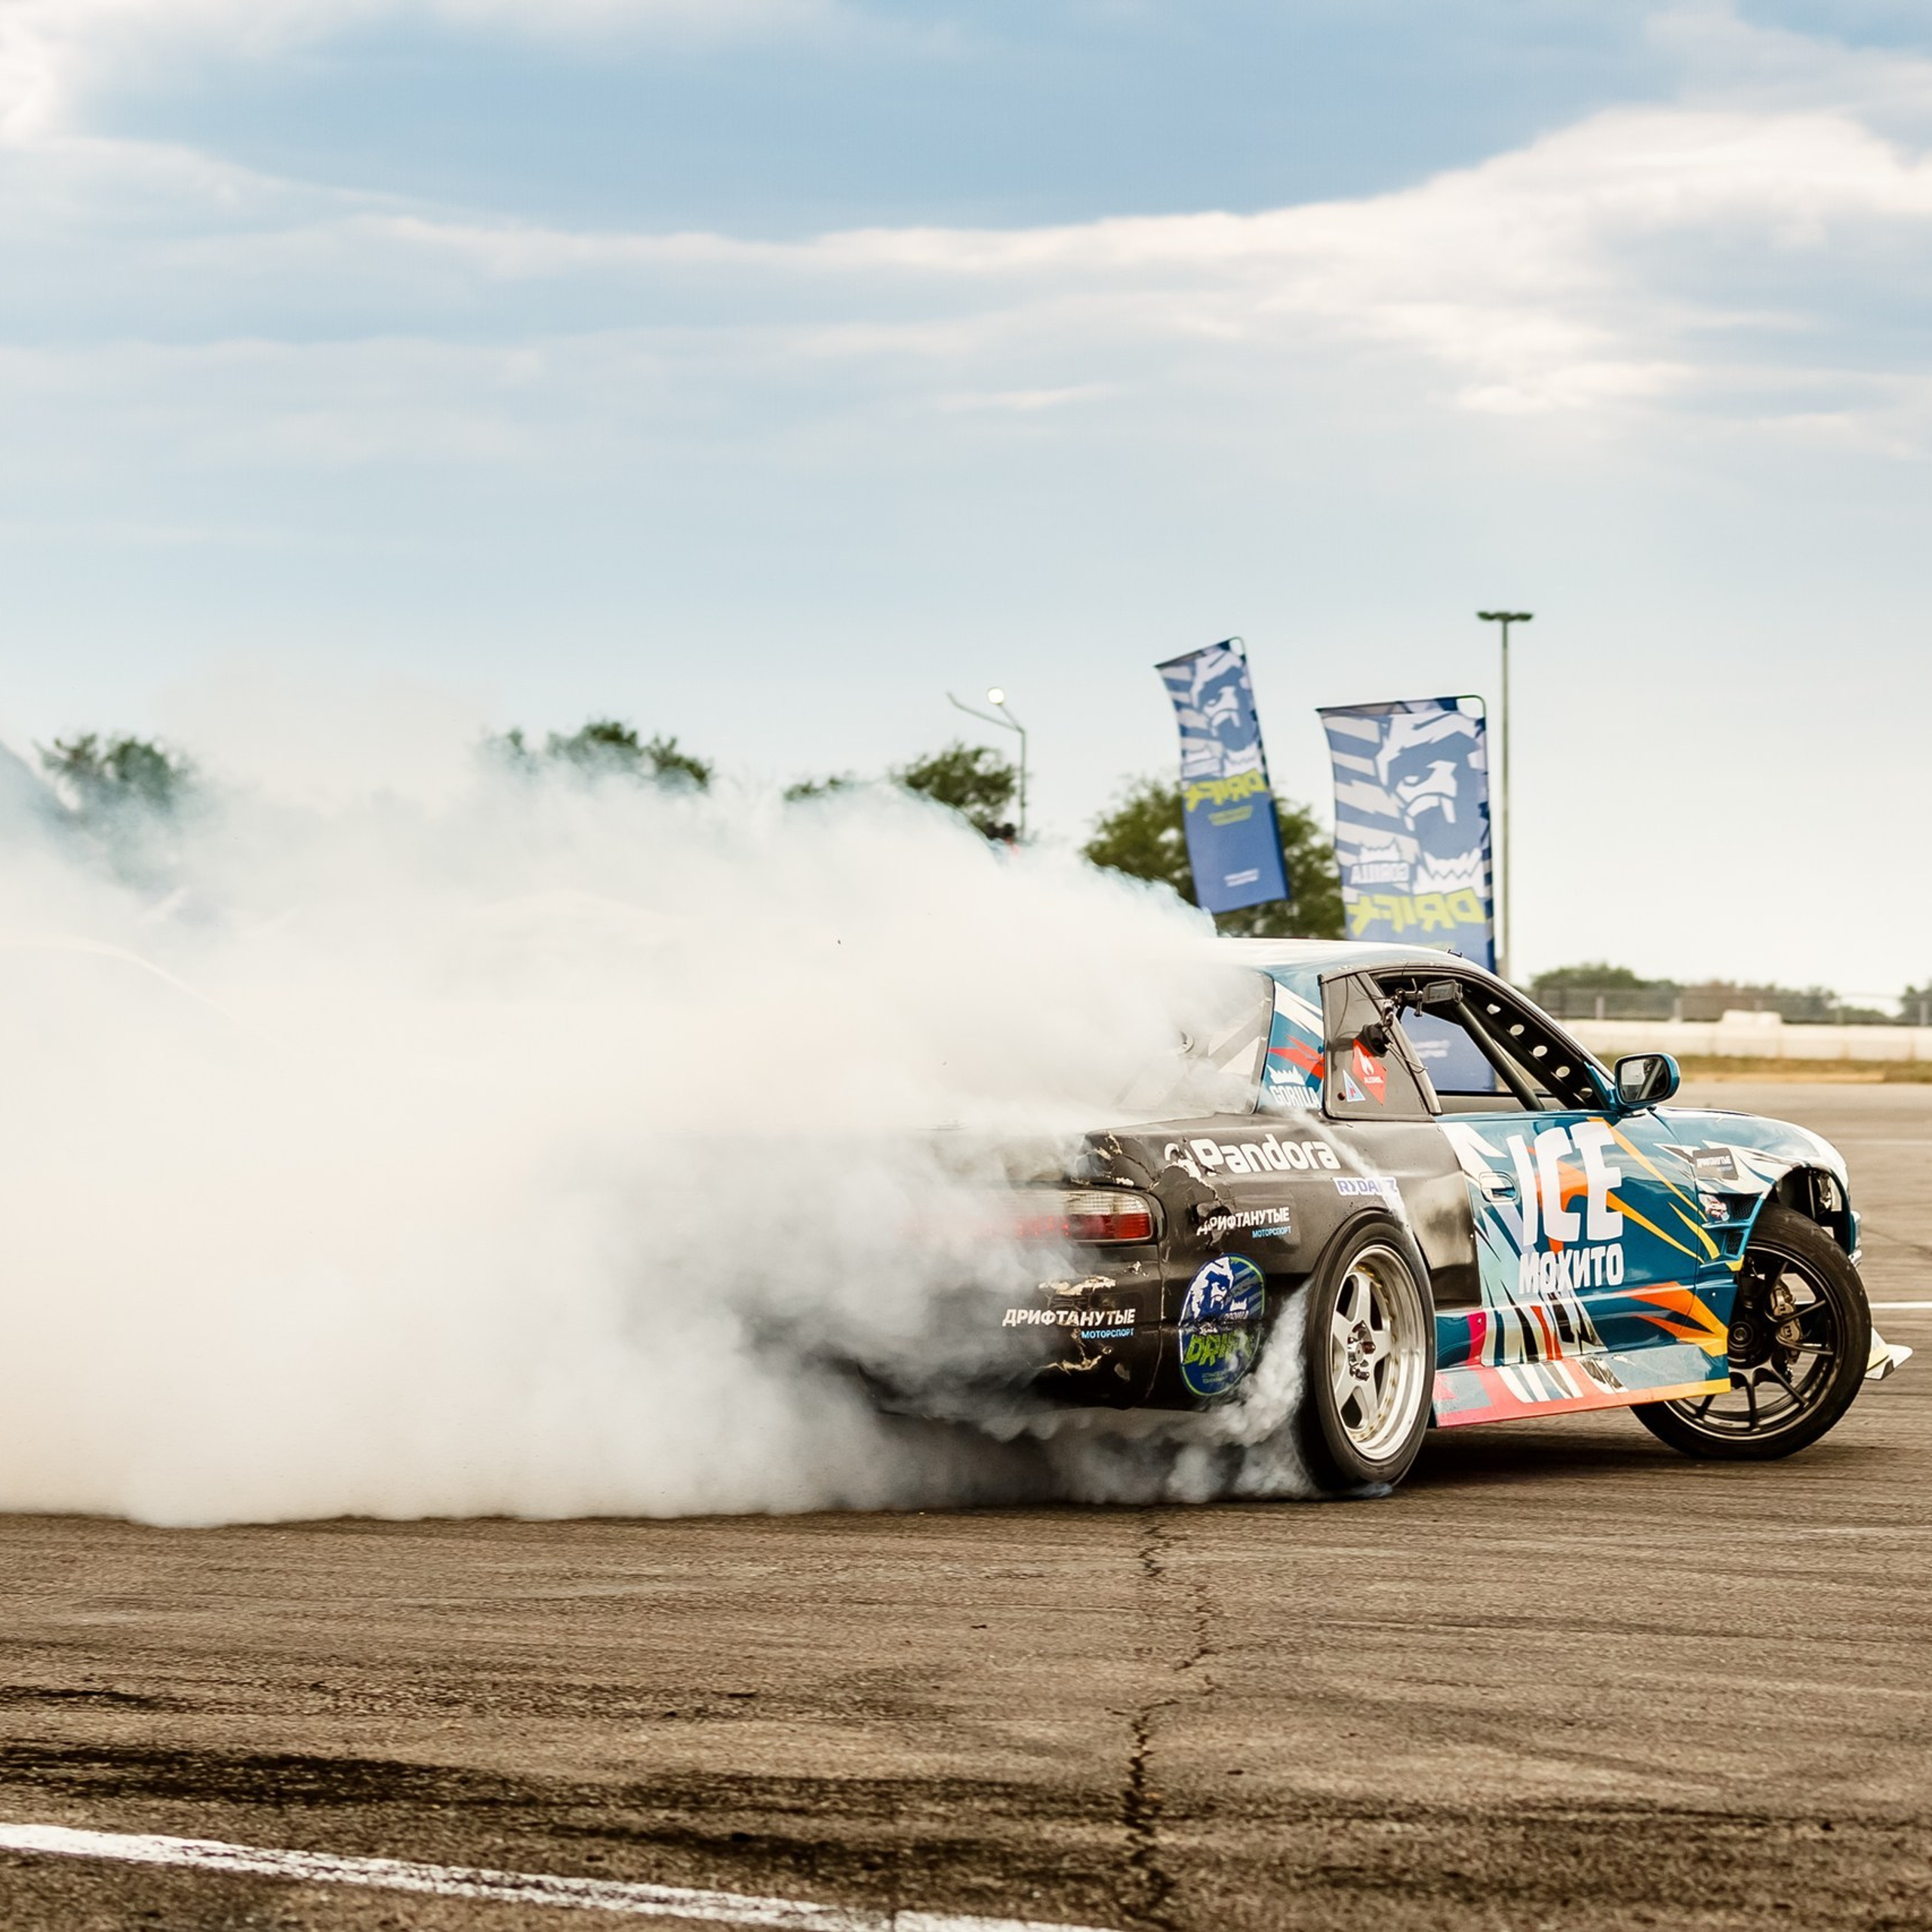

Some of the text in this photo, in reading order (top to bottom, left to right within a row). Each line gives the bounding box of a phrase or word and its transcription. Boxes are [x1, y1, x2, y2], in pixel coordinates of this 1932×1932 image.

[1269, 1085, 1322, 1109] GORILLA
[1189, 1134, 1341, 1176] Pandora
[1337, 1180, 1398, 1192] RYDAZ
[1506, 1121, 1623, 1246] ICE
[1196, 1207, 1290, 1236] ДРИФТАНУТЫЕ
[1252, 1218, 1291, 1238] МОТОРСПОРТ
[1518, 1243, 1624, 1294] МОХИТО
[1002, 1309, 1137, 1327] ДРИФТАНУТЫЕ
[1081, 1327, 1134, 1339] МОТОРСПОРТ
